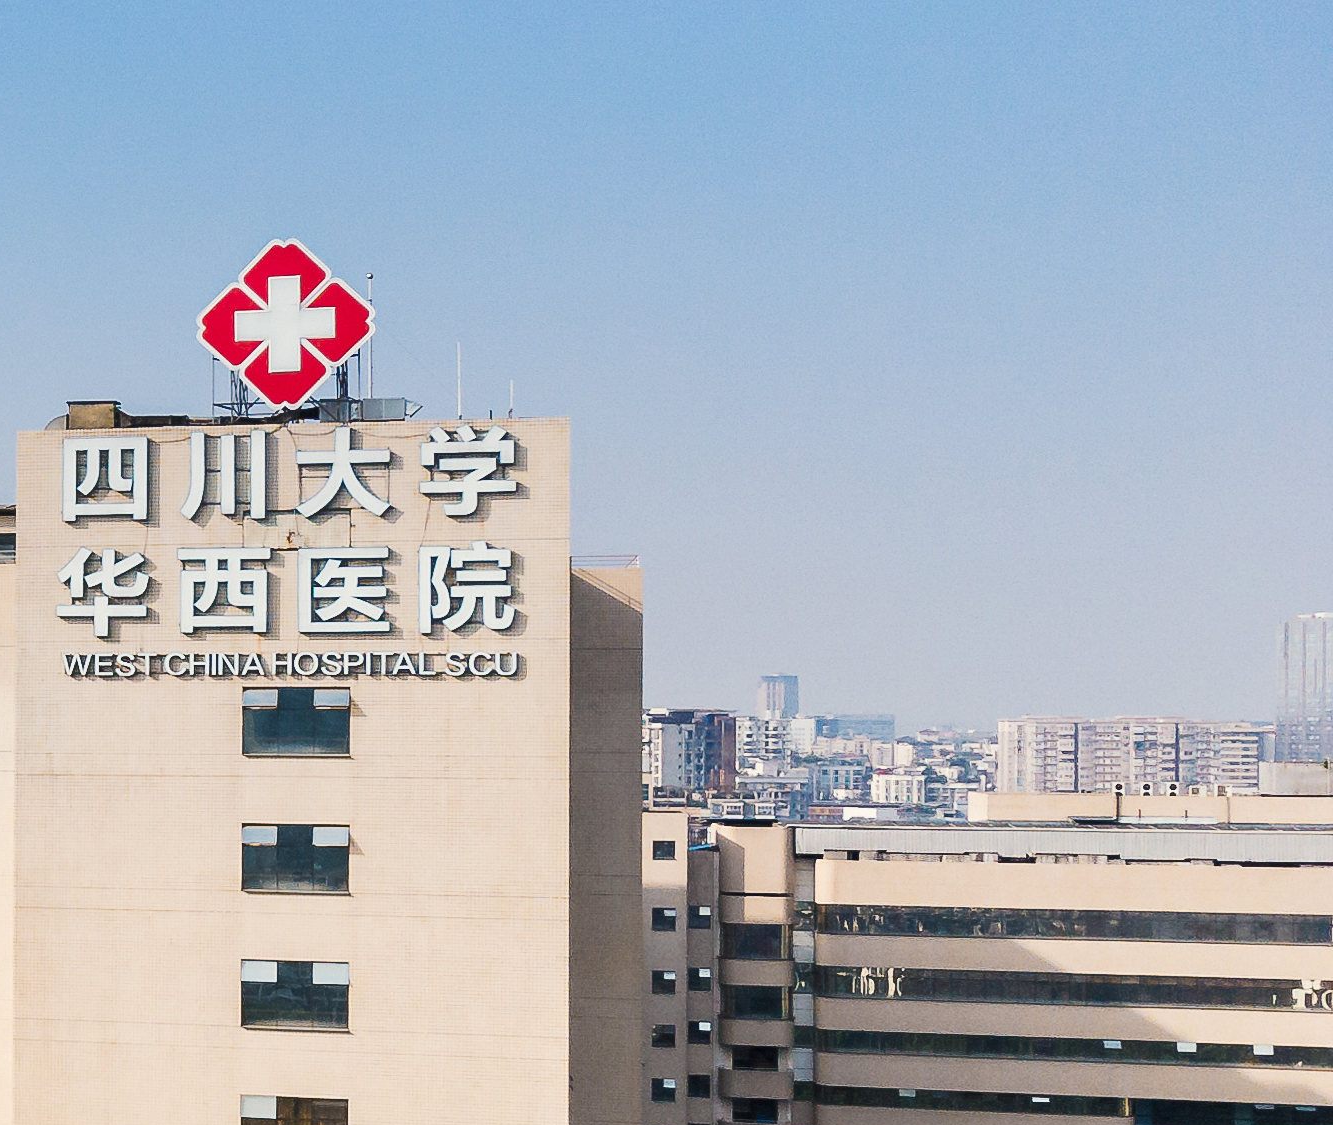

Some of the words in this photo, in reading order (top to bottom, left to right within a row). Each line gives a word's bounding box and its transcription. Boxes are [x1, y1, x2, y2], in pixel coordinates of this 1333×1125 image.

[61, 424, 517, 522] 四川大学
[56, 540, 517, 636] 华西医院
[61, 652, 157, 677] WEST
[163, 652, 265, 677] CHINA
[271, 651, 437, 676] HOSPITAL
[444, 651, 518, 677] SCU
